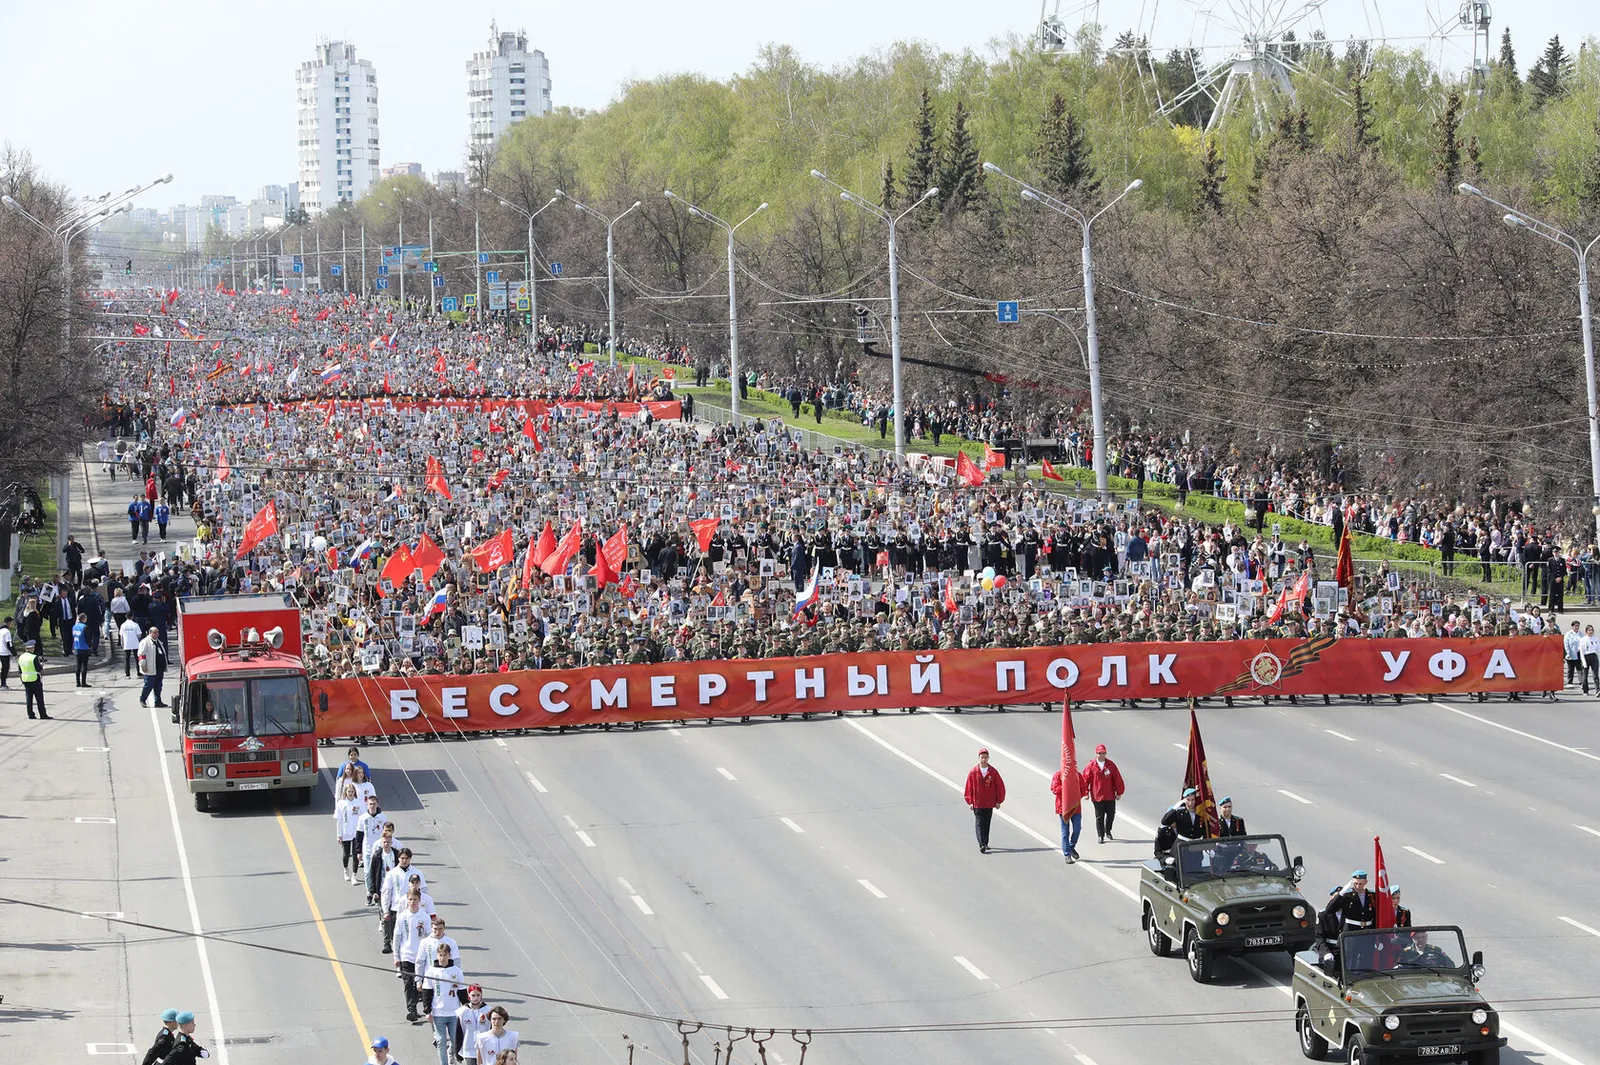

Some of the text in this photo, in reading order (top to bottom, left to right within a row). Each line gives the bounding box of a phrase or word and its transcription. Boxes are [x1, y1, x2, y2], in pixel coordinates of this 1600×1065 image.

[391, 648, 1517, 720] БЕССМЕРТНЫЙ ПОЛК УФА
